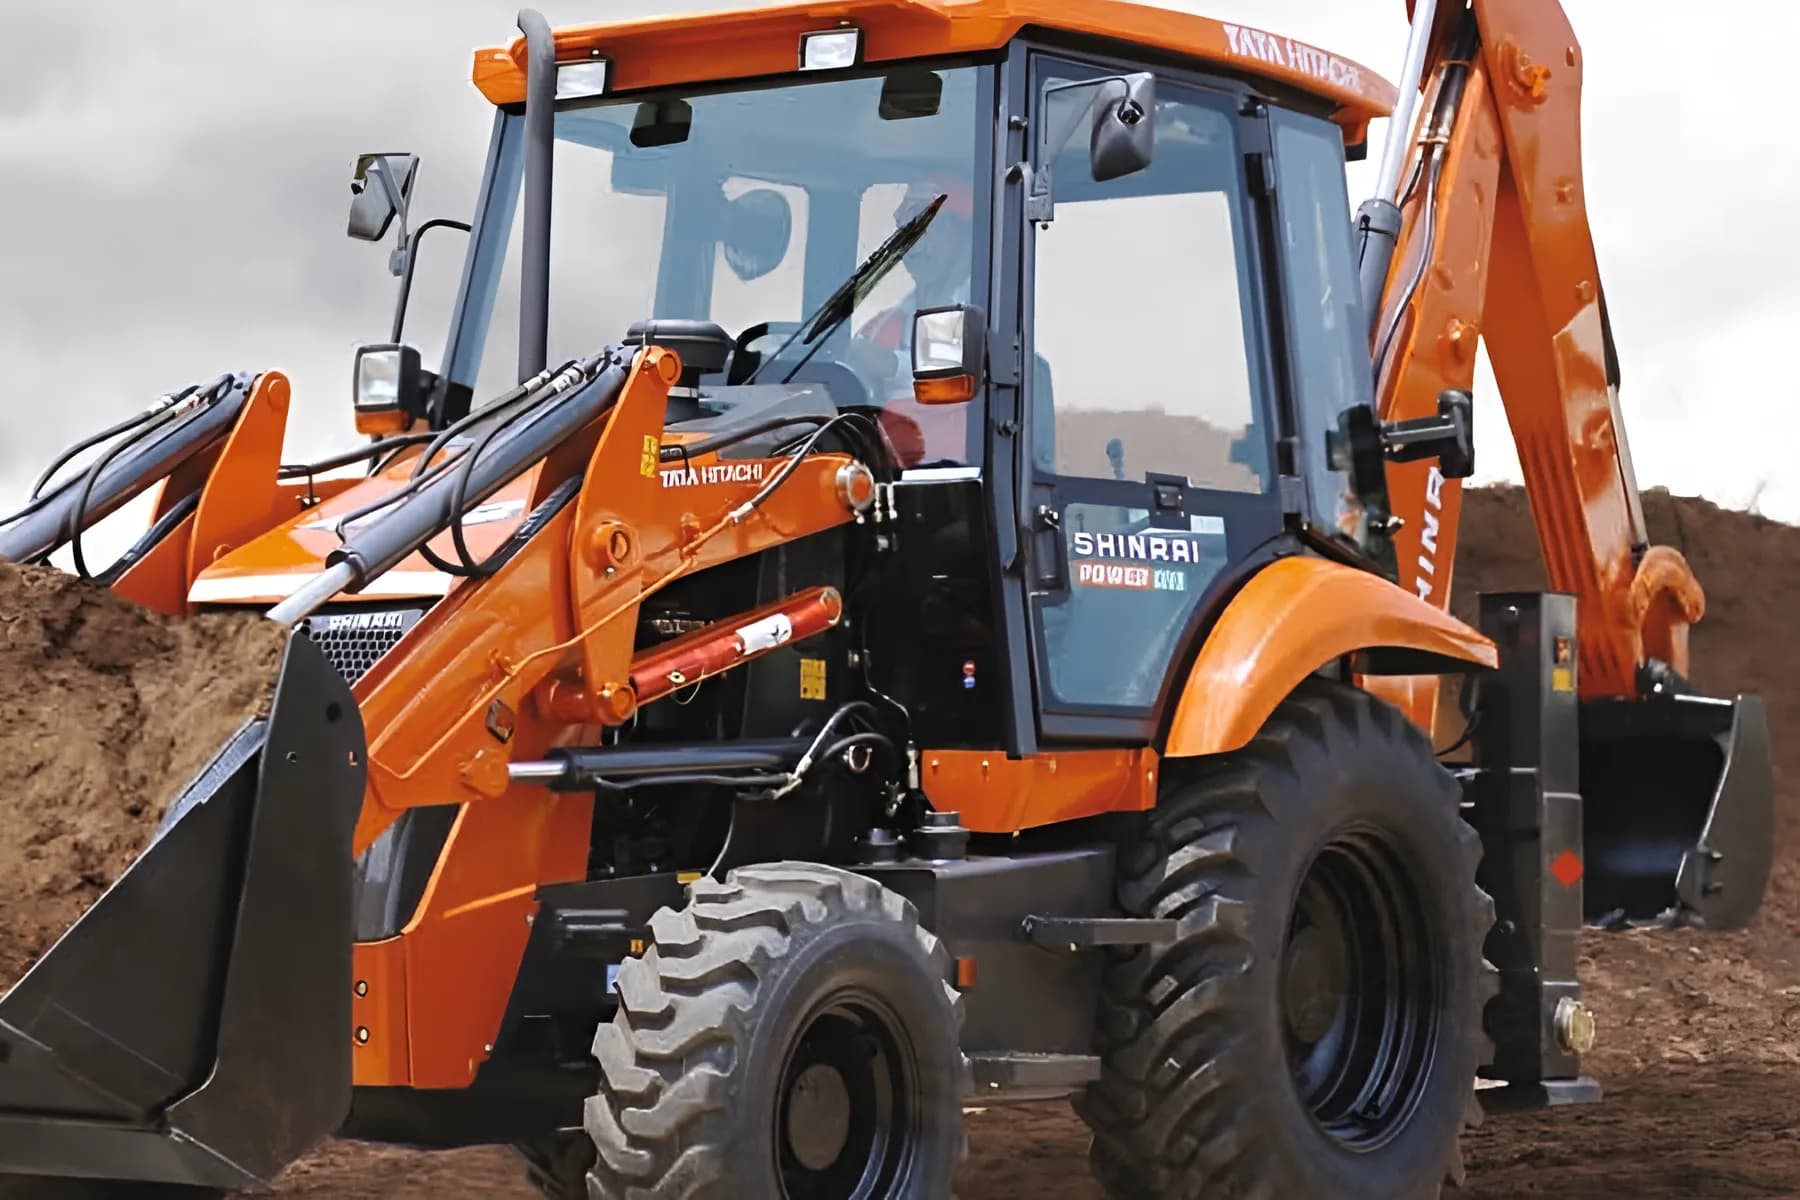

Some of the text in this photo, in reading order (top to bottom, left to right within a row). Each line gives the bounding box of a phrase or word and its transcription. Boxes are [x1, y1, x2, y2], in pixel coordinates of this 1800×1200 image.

[1223, 23, 1285, 66] TATA
[659, 463, 762, 488] TATA HITACHI
[1074, 532, 1199, 563] SHINRAI
